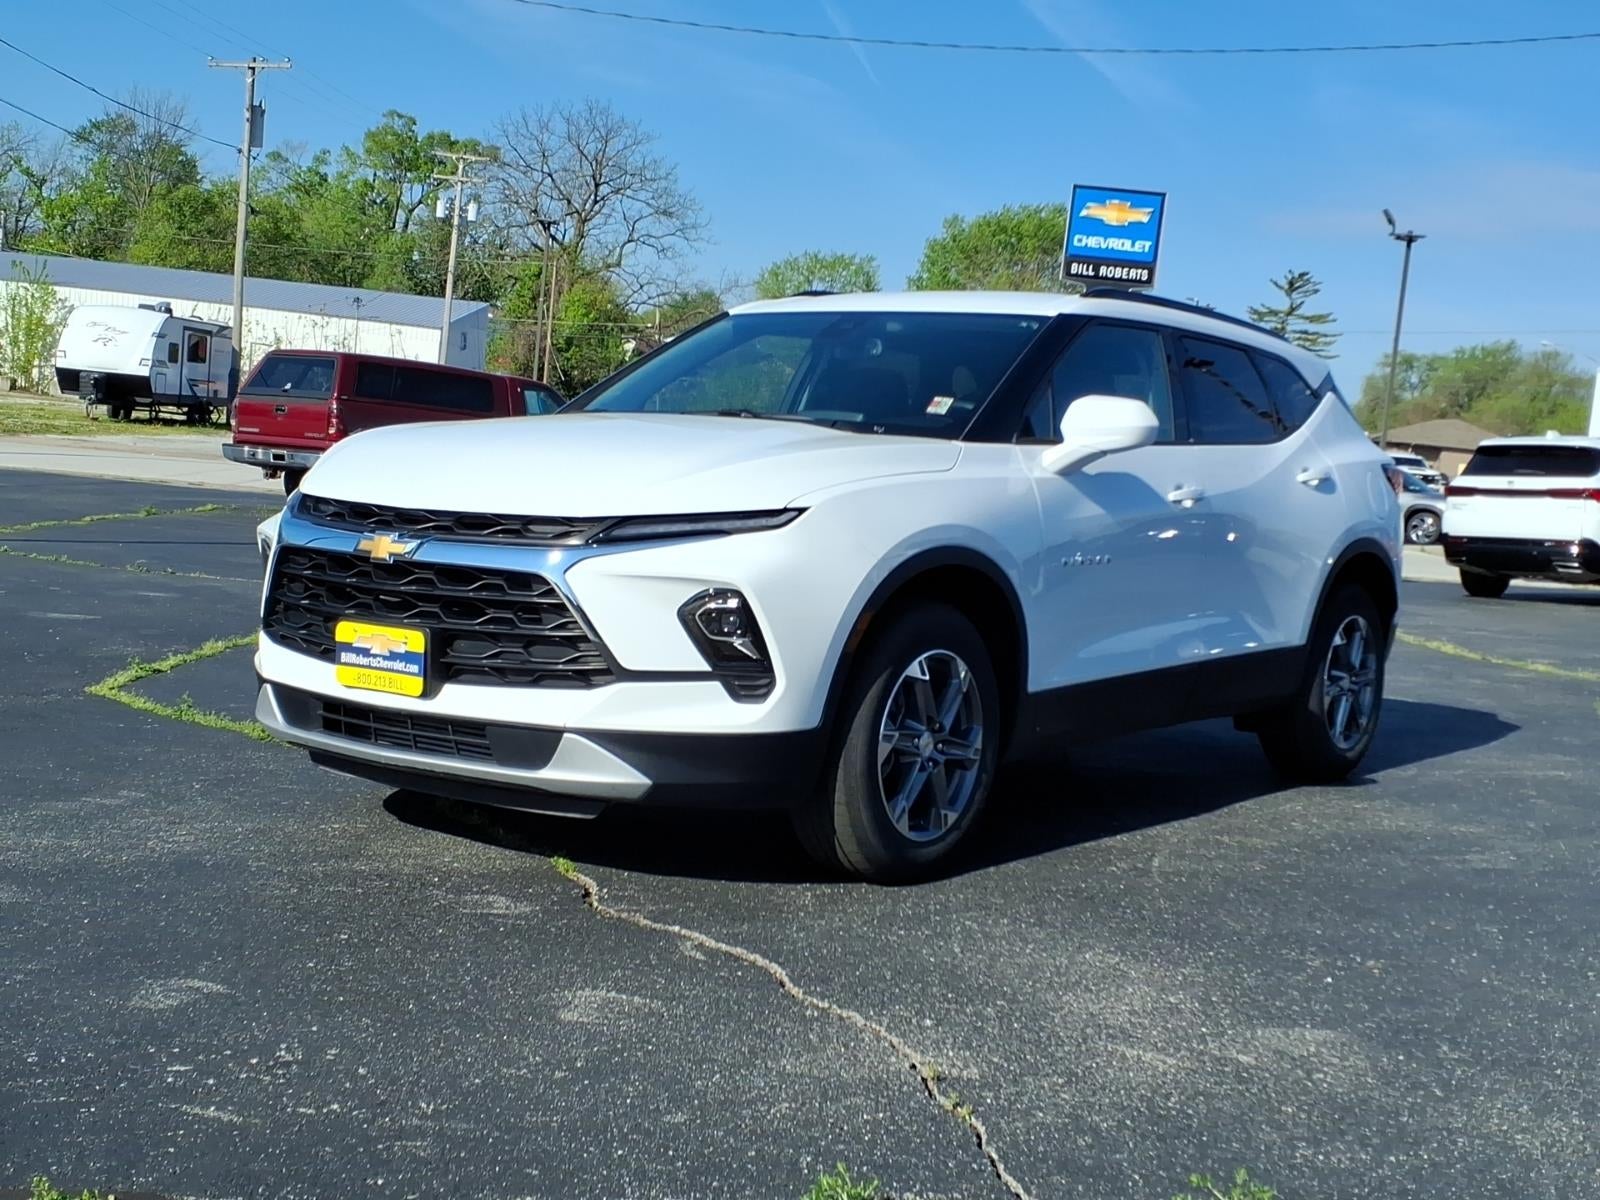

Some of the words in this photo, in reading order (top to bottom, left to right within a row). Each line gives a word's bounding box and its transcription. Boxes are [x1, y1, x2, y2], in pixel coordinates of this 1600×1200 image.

[1072, 233, 1152, 253] CHEVROLET
[1070, 262, 1096, 277] BILL
[1099, 265, 1149, 281] ROBERTS
[340, 651, 419, 673] BillRobertsChevrolet.com
